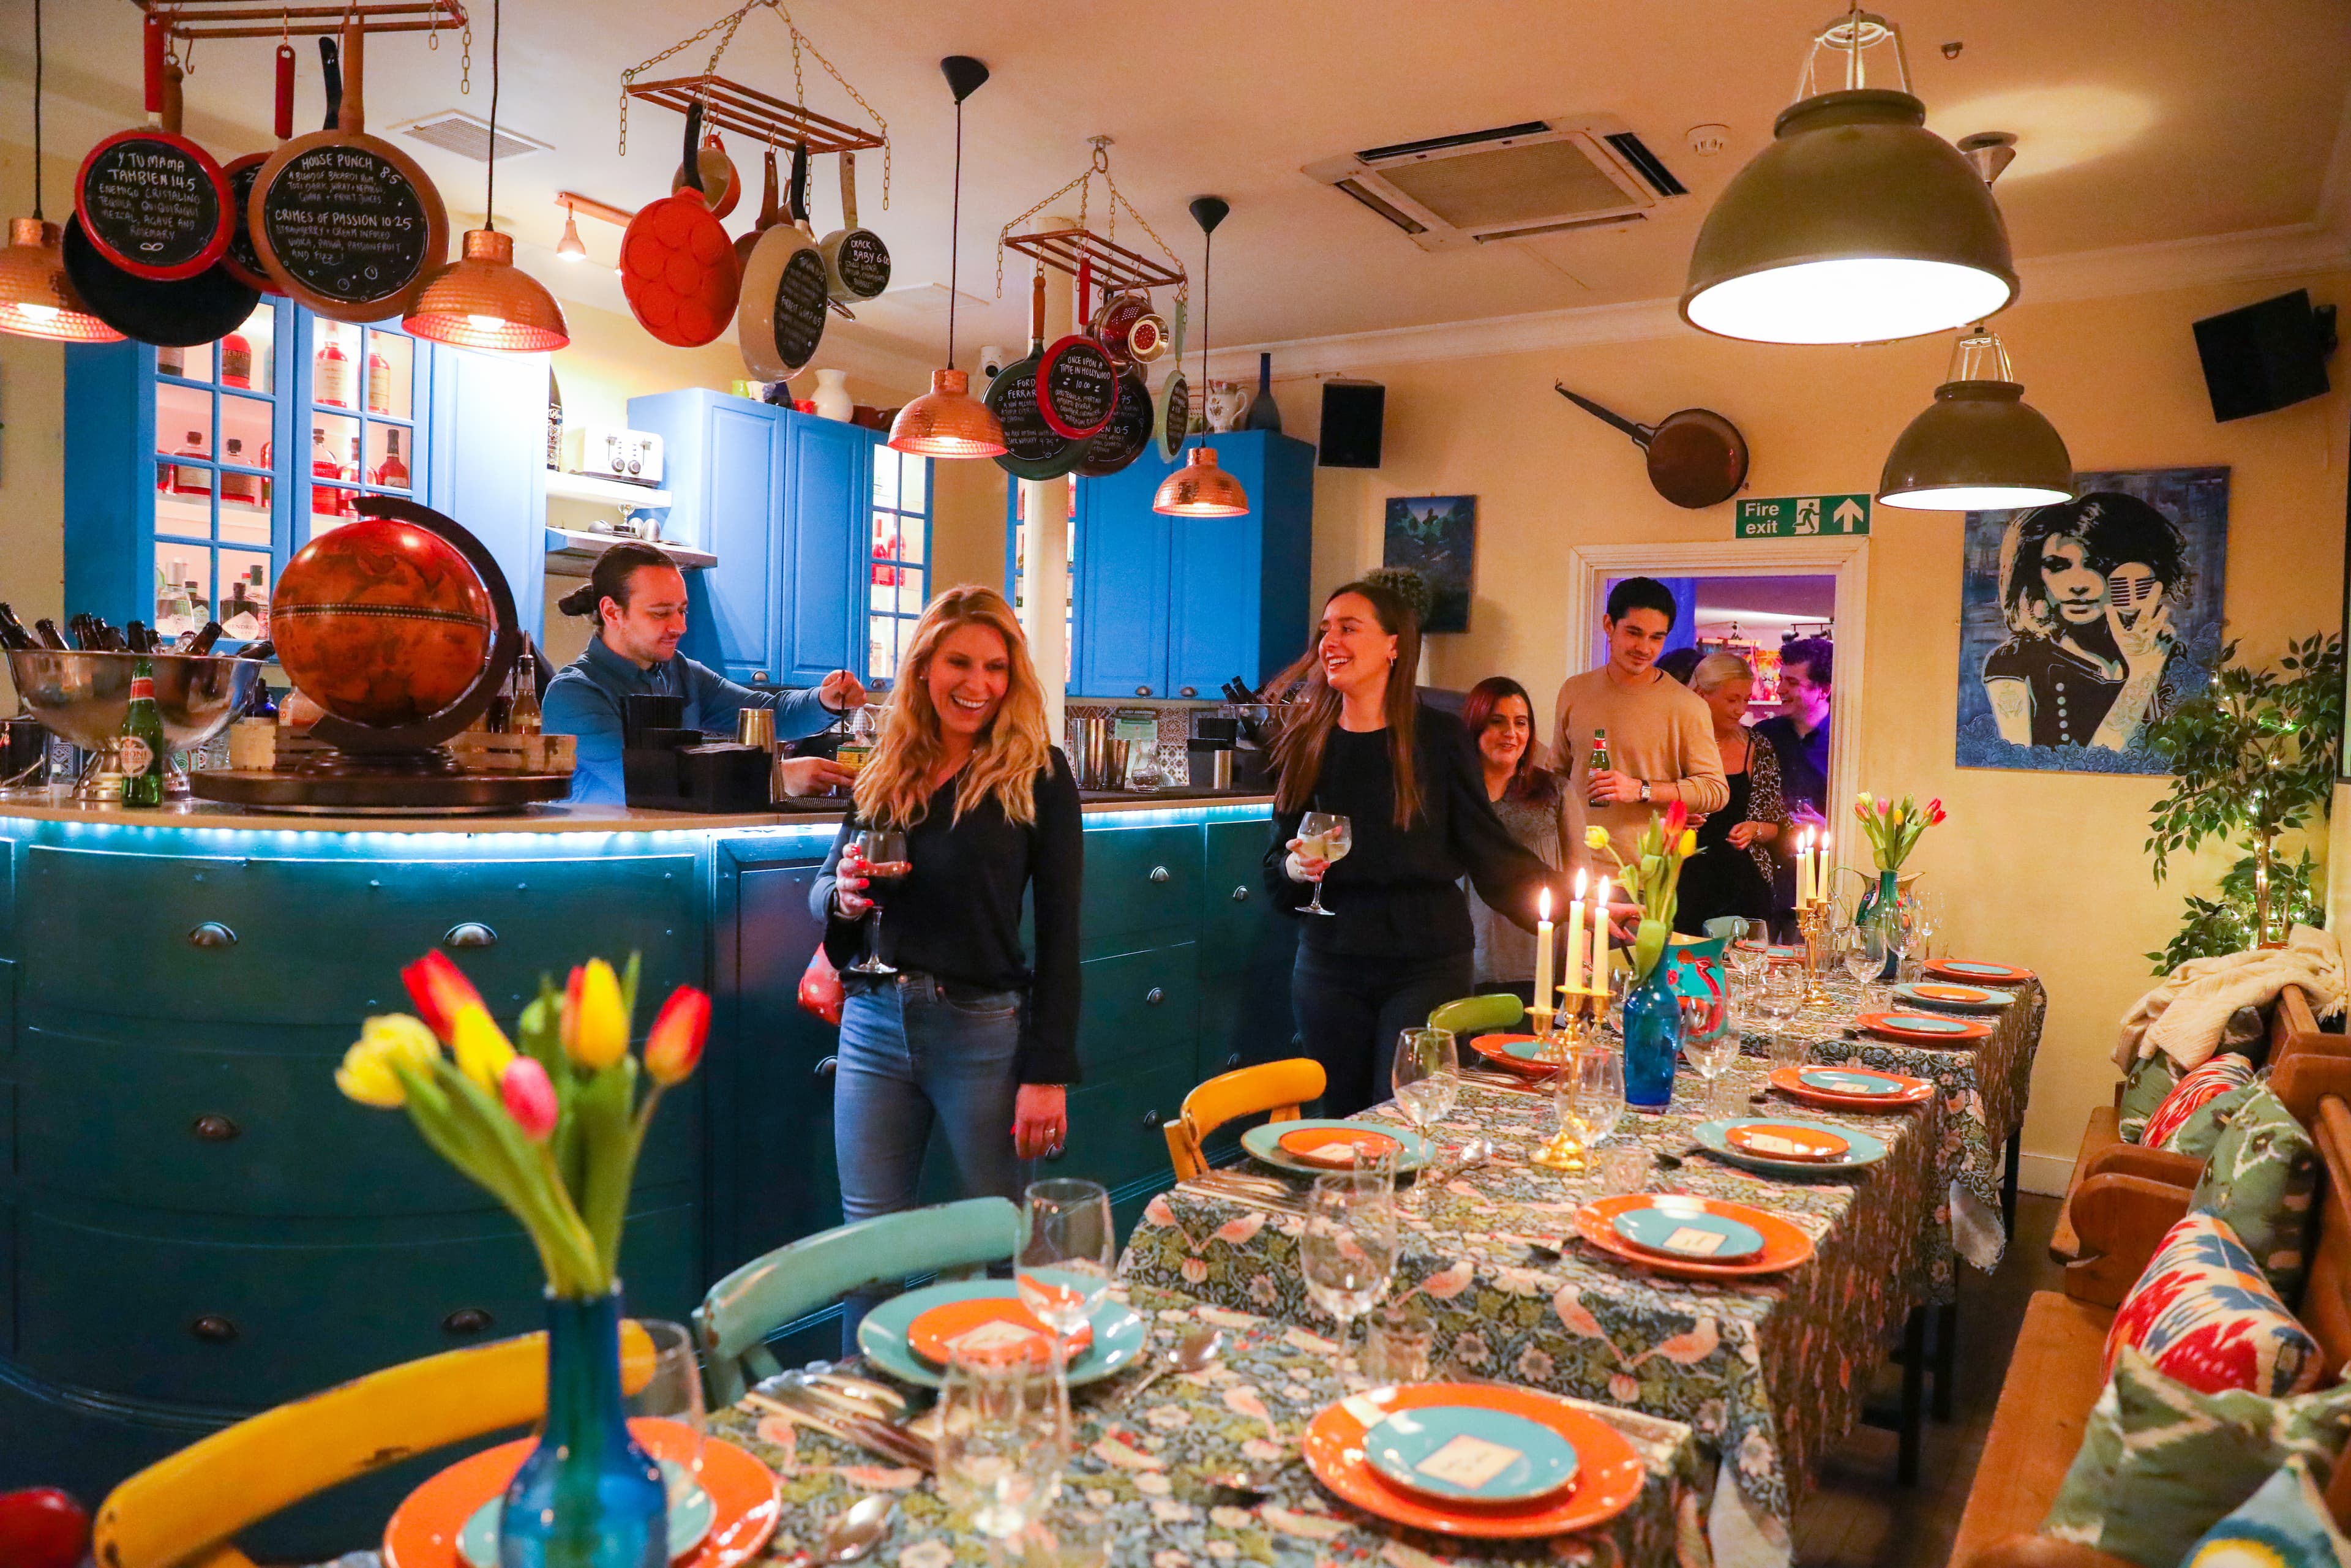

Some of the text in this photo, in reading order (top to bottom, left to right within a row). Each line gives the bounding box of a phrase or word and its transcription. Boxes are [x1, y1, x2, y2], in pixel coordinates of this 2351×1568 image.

[118, 152, 185, 173] Y TU MAMA
[302, 154, 332, 170] HOUSE
[337, 153, 373, 171] PUNCH
[108, 169, 168, 186] TAMBIEN
[145, 188, 201, 204] CRISTALINO
[144, 214, 173, 228] AGAVE
[275, 208, 313, 224] CRIMES
[317, 212, 329, 225] OF
[332, 212, 378, 227] PASSION
[851, 240, 872, 250] CRACK
[853, 250, 874, 263] BABY
[1068, 356, 1081, 365] ONCE
[1082, 357, 1097, 368] UPON
[1059, 363, 1073, 375] TIME
[1081, 367, 1111, 380] HOLLYWOOD
[1017, 379, 1036, 388] FORD
[1007, 389, 1037, 400] FERRAR
[1745, 502, 1779, 517] Fire
[1745, 519, 1778, 535] exit
